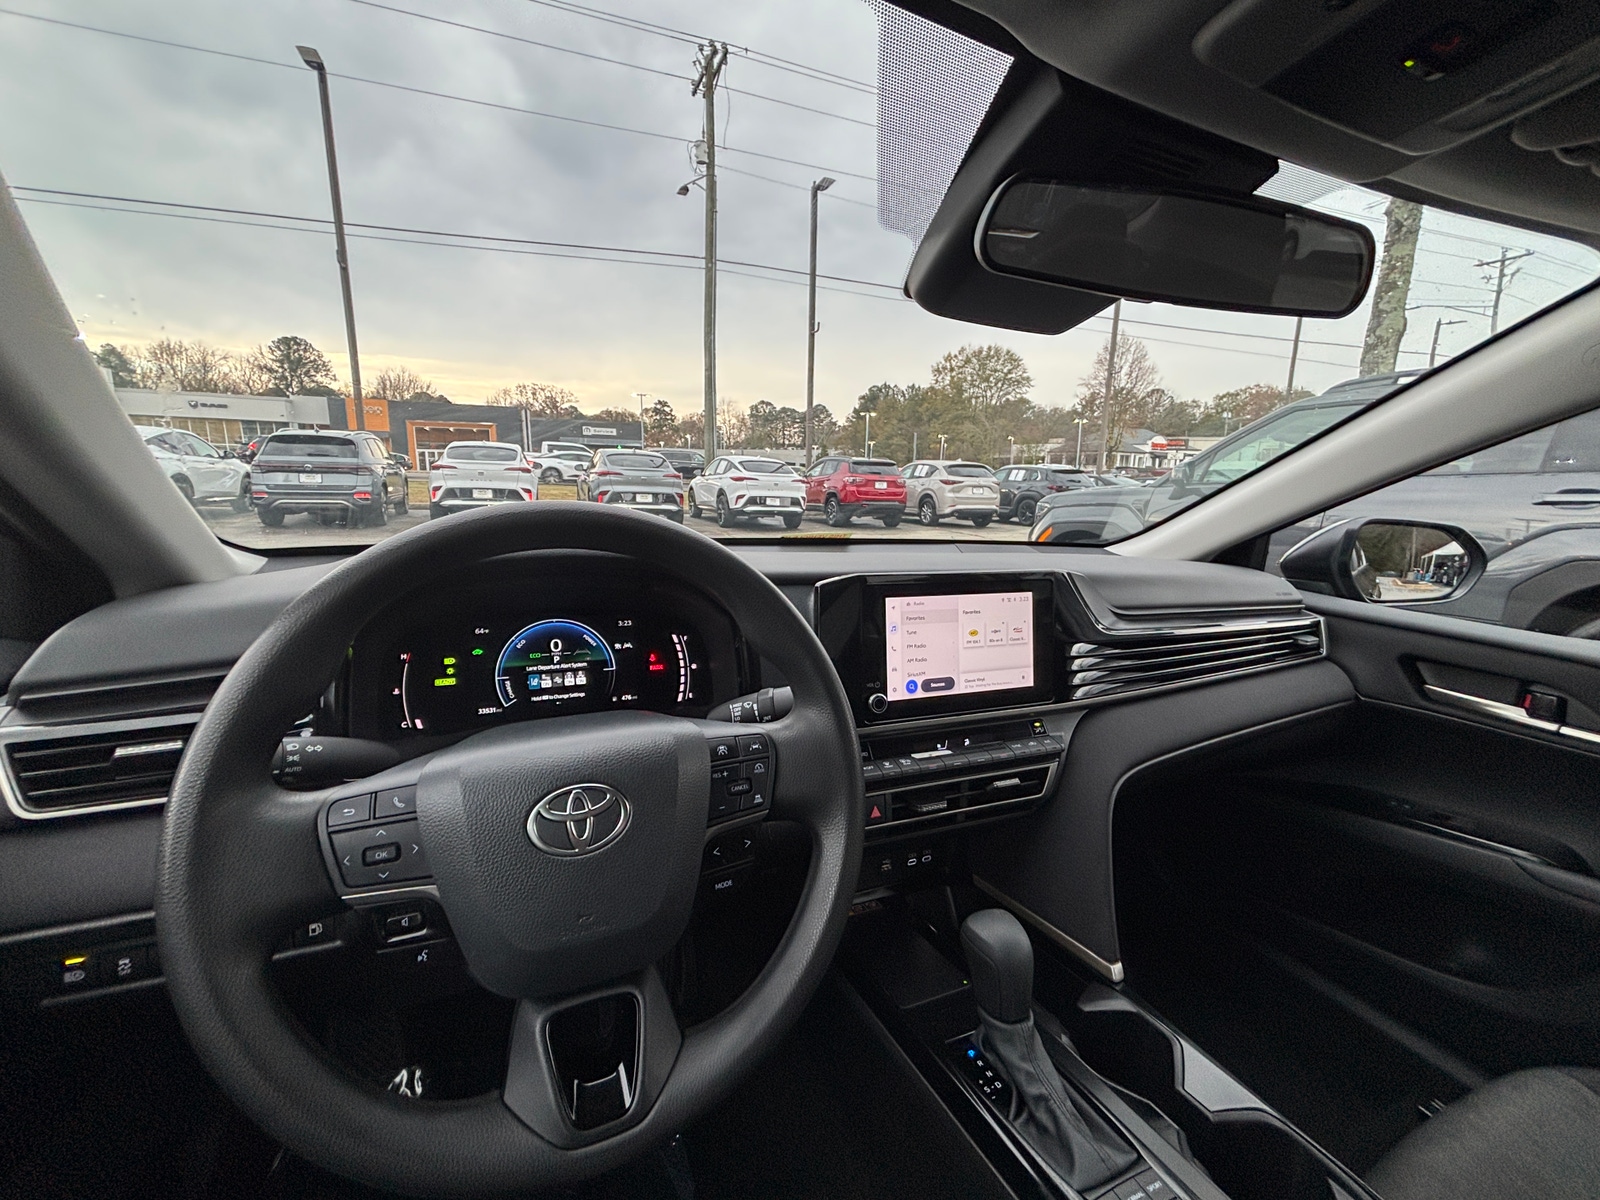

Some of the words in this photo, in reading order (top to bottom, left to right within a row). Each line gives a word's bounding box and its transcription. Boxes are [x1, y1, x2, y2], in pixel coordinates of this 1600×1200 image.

[516, 639, 526, 649] ECO
[550, 638, 562, 652] 0
[553, 656, 560, 664] P
[376, 850, 387, 859] OK
[715, 880, 732, 890] MODE
[967, 1050, 975, 1058] P
[1146, 1180, 1162, 1192] SPORT
